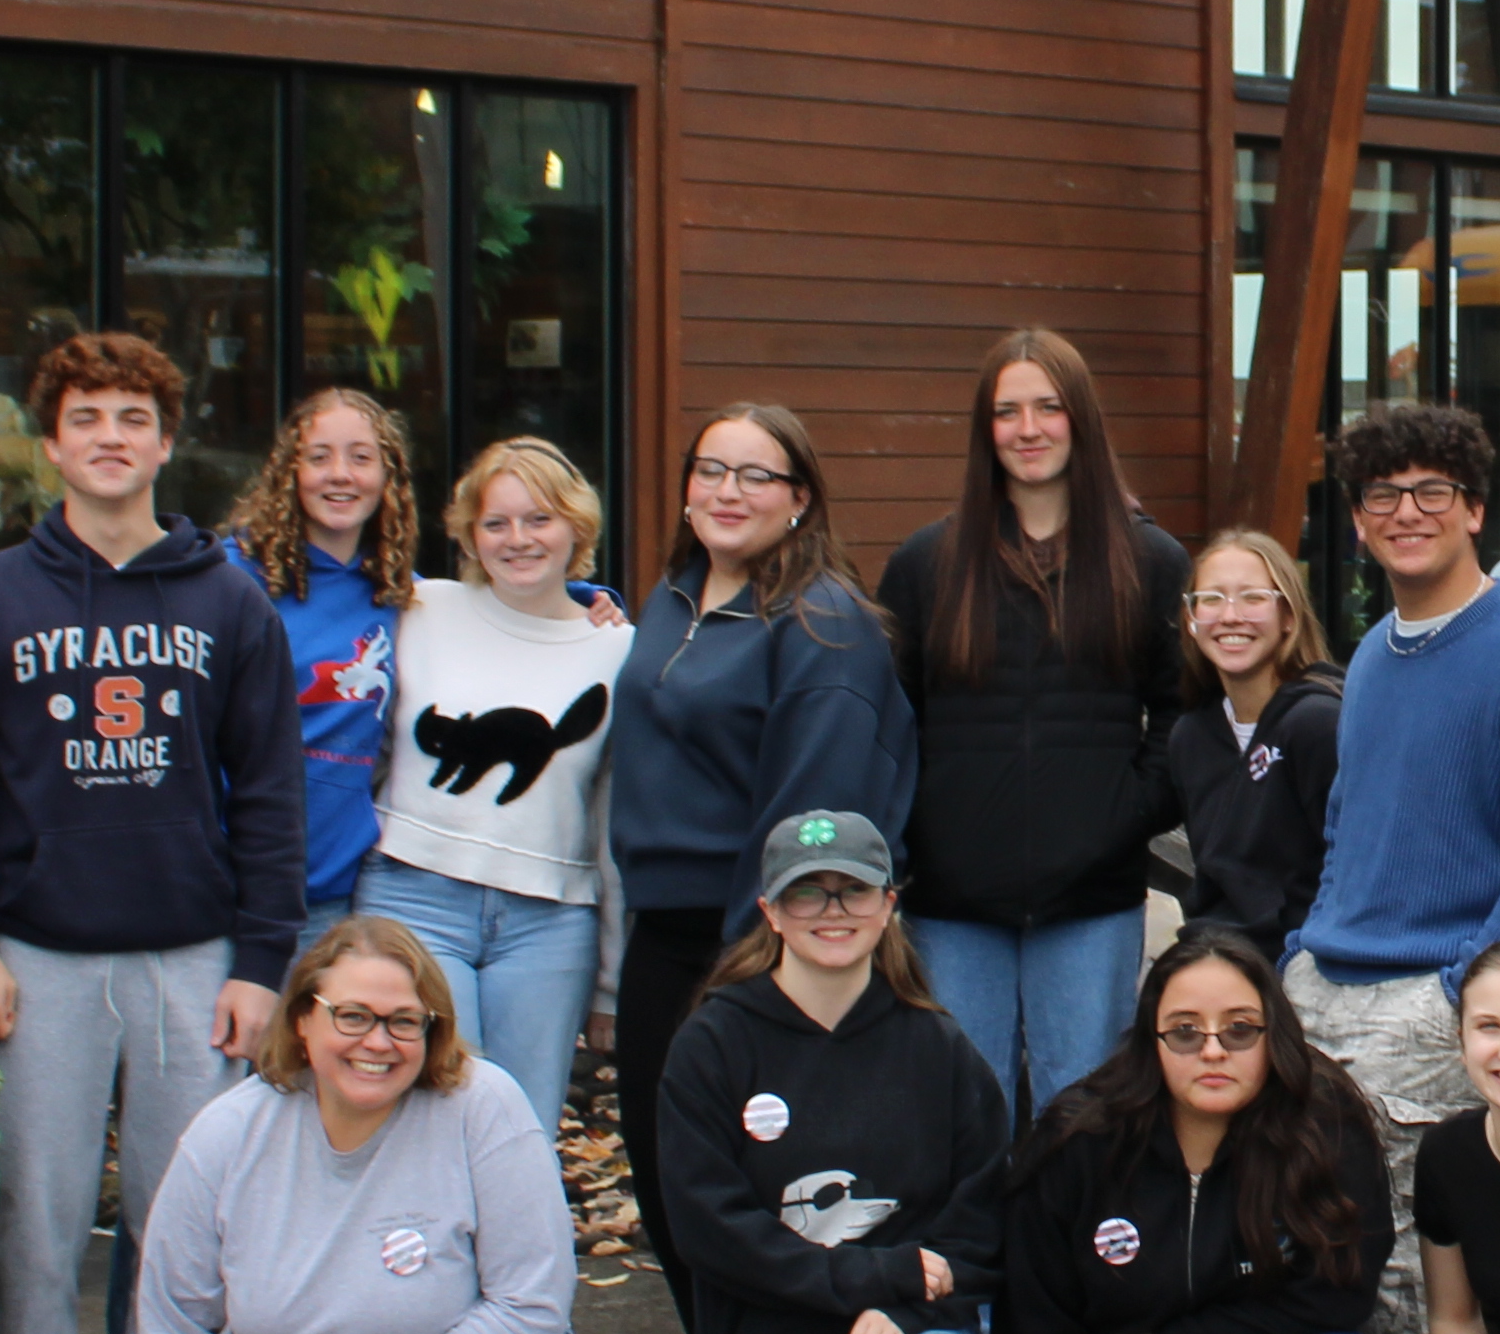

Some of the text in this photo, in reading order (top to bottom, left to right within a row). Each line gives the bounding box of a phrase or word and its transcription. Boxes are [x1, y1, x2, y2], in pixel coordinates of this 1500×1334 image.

[13, 623, 214, 684] SYRACUSE
[94, 675, 145, 739] S
[64, 735, 172, 771] ORANGE
